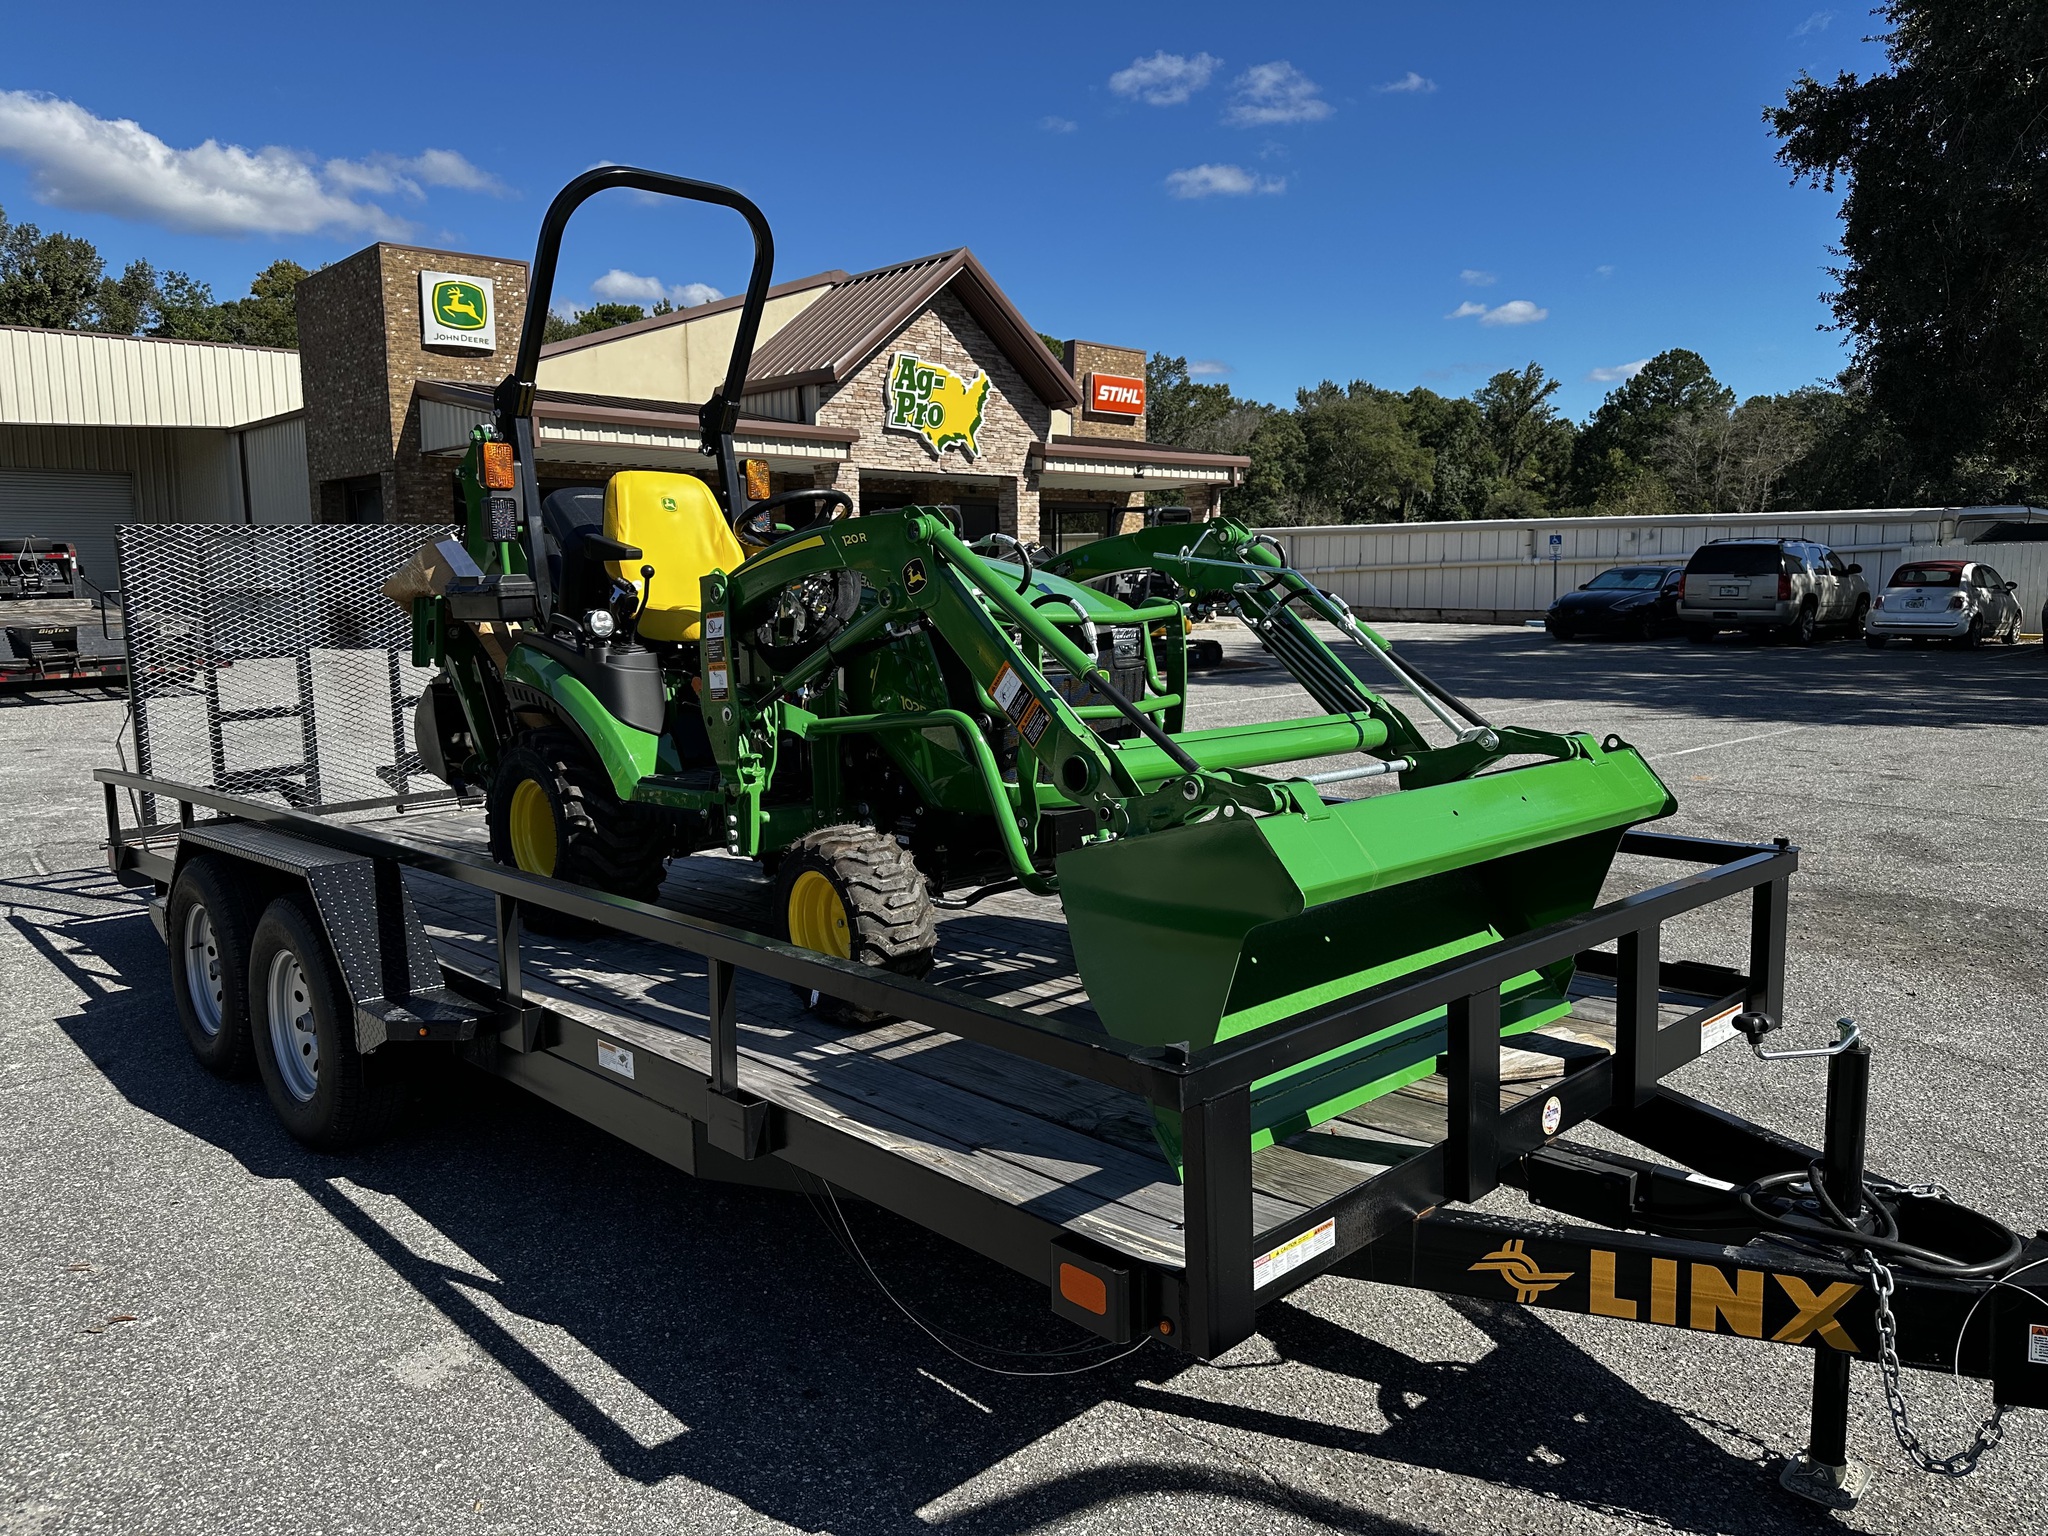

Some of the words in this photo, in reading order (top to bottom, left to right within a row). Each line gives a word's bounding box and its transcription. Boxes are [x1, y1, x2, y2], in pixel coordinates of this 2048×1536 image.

[433, 332, 460, 341] JOHN
[460, 334, 490, 345] DEERE
[894, 357, 945, 401] Ag-
[1098, 385, 1141, 404] STIHL
[894, 390, 944, 427] Pro
[1589, 1249, 1864, 1353] LINX
